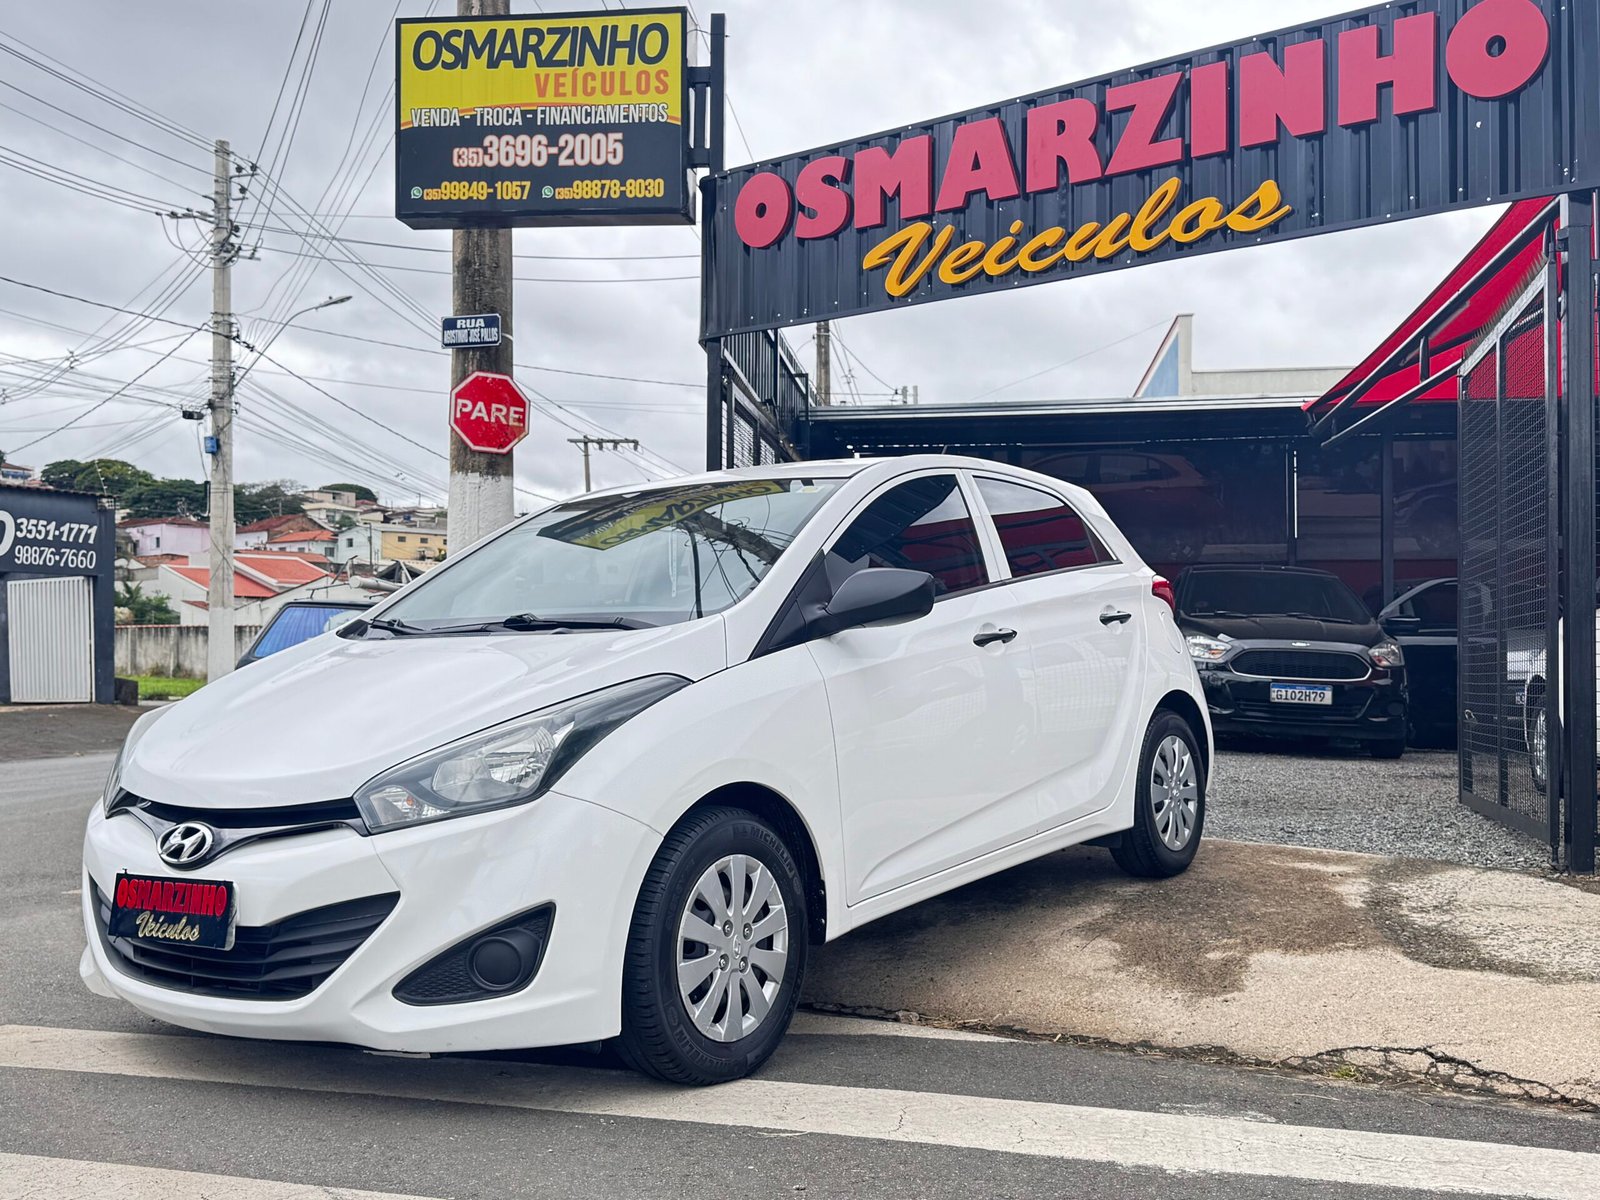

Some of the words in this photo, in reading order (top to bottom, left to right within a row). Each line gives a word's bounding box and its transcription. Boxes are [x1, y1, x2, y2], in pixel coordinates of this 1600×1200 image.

[413, 23, 669, 71] OSMARZINHO
[535, 69, 670, 98] VEÍCULOS
[410, 107, 461, 128] VENDA
[476, 106, 523, 127] TROCA
[536, 103, 669, 126] FINANCIAMENTOS
[735, 0, 1549, 248] OSMARZINHO
[862, 177, 1291, 297] Veiculos
[456, 318, 485, 329] RUA
[455, 398, 525, 427] PARE
[750, 825, 795, 879] MICHELIN
[116, 878, 228, 917] OSMARZINHO
